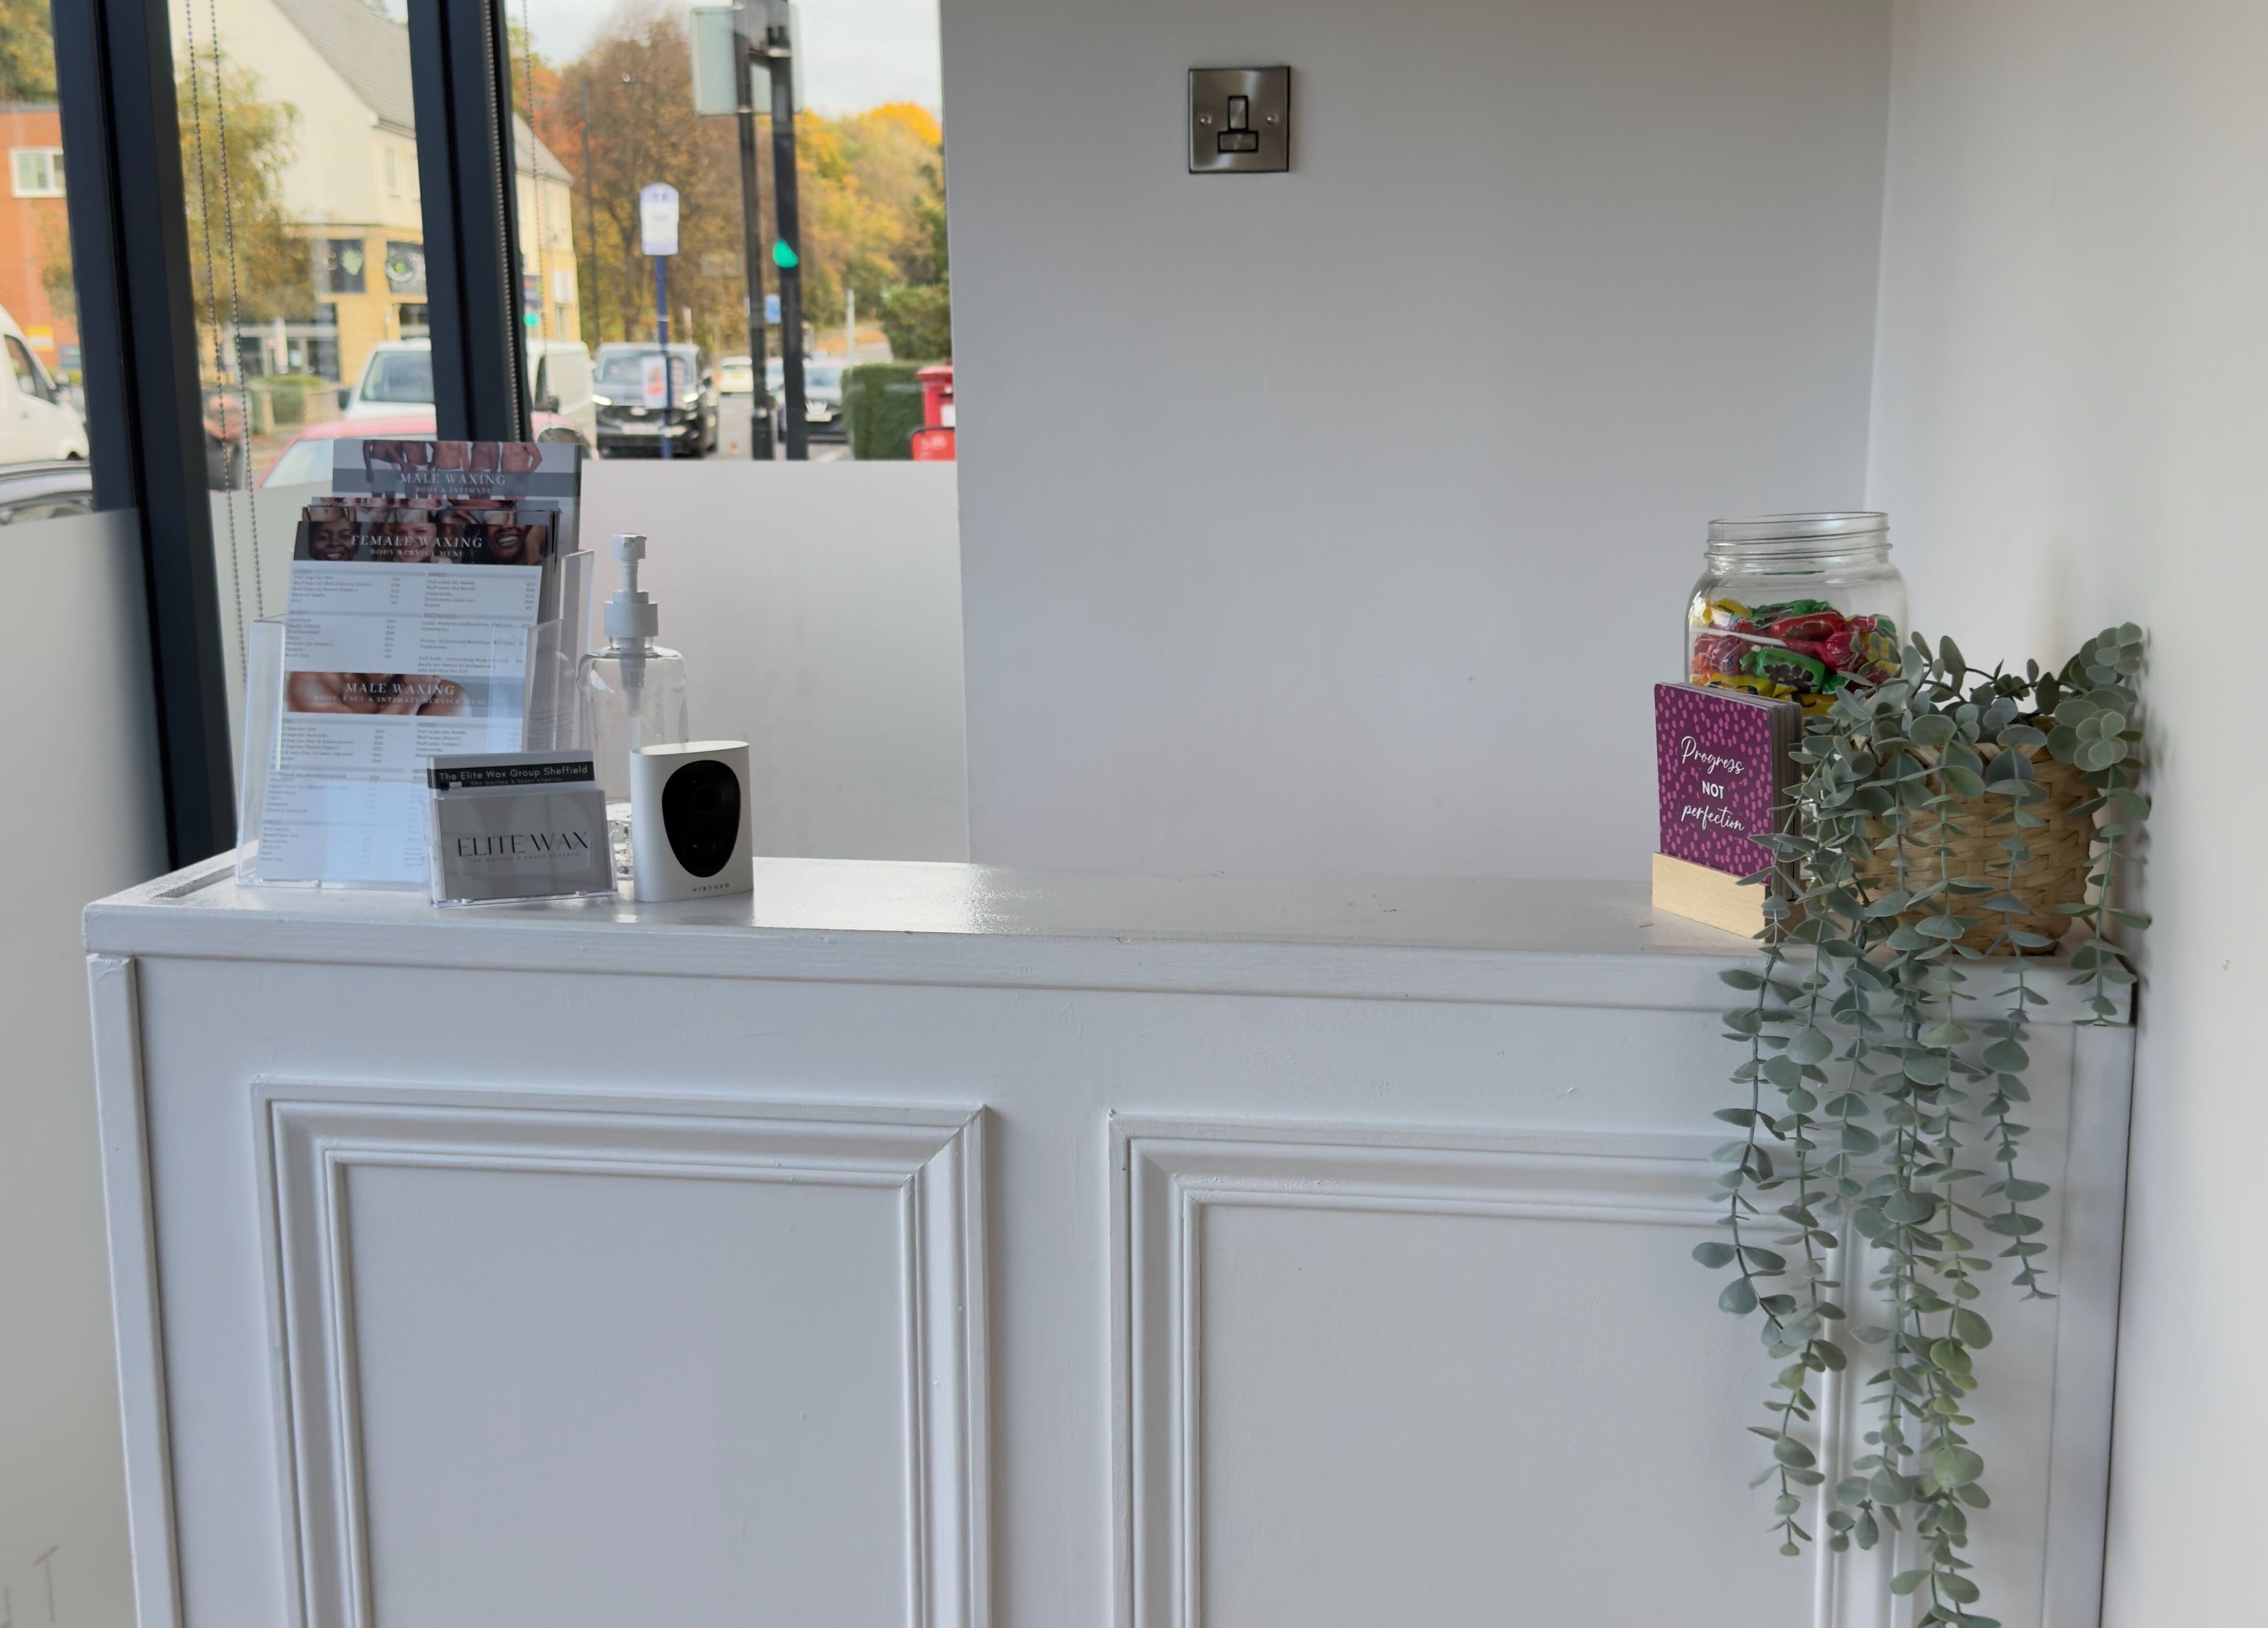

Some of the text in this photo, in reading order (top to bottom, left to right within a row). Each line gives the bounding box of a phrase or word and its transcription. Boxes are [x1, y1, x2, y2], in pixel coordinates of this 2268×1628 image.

[399, 473, 506, 485] MALE WAXING
[350, 535, 483, 548] FEMALE WAXING
[346, 682, 455, 696] MALE WAXING
[1681, 736, 1744, 774] Progress
[439, 765, 588, 781] The Elite Wax Group Sheffield
[1702, 780, 1725, 799] NOT
[1681, 804, 1745, 831] perfection
[457, 831, 589, 857] ELITE WAX
